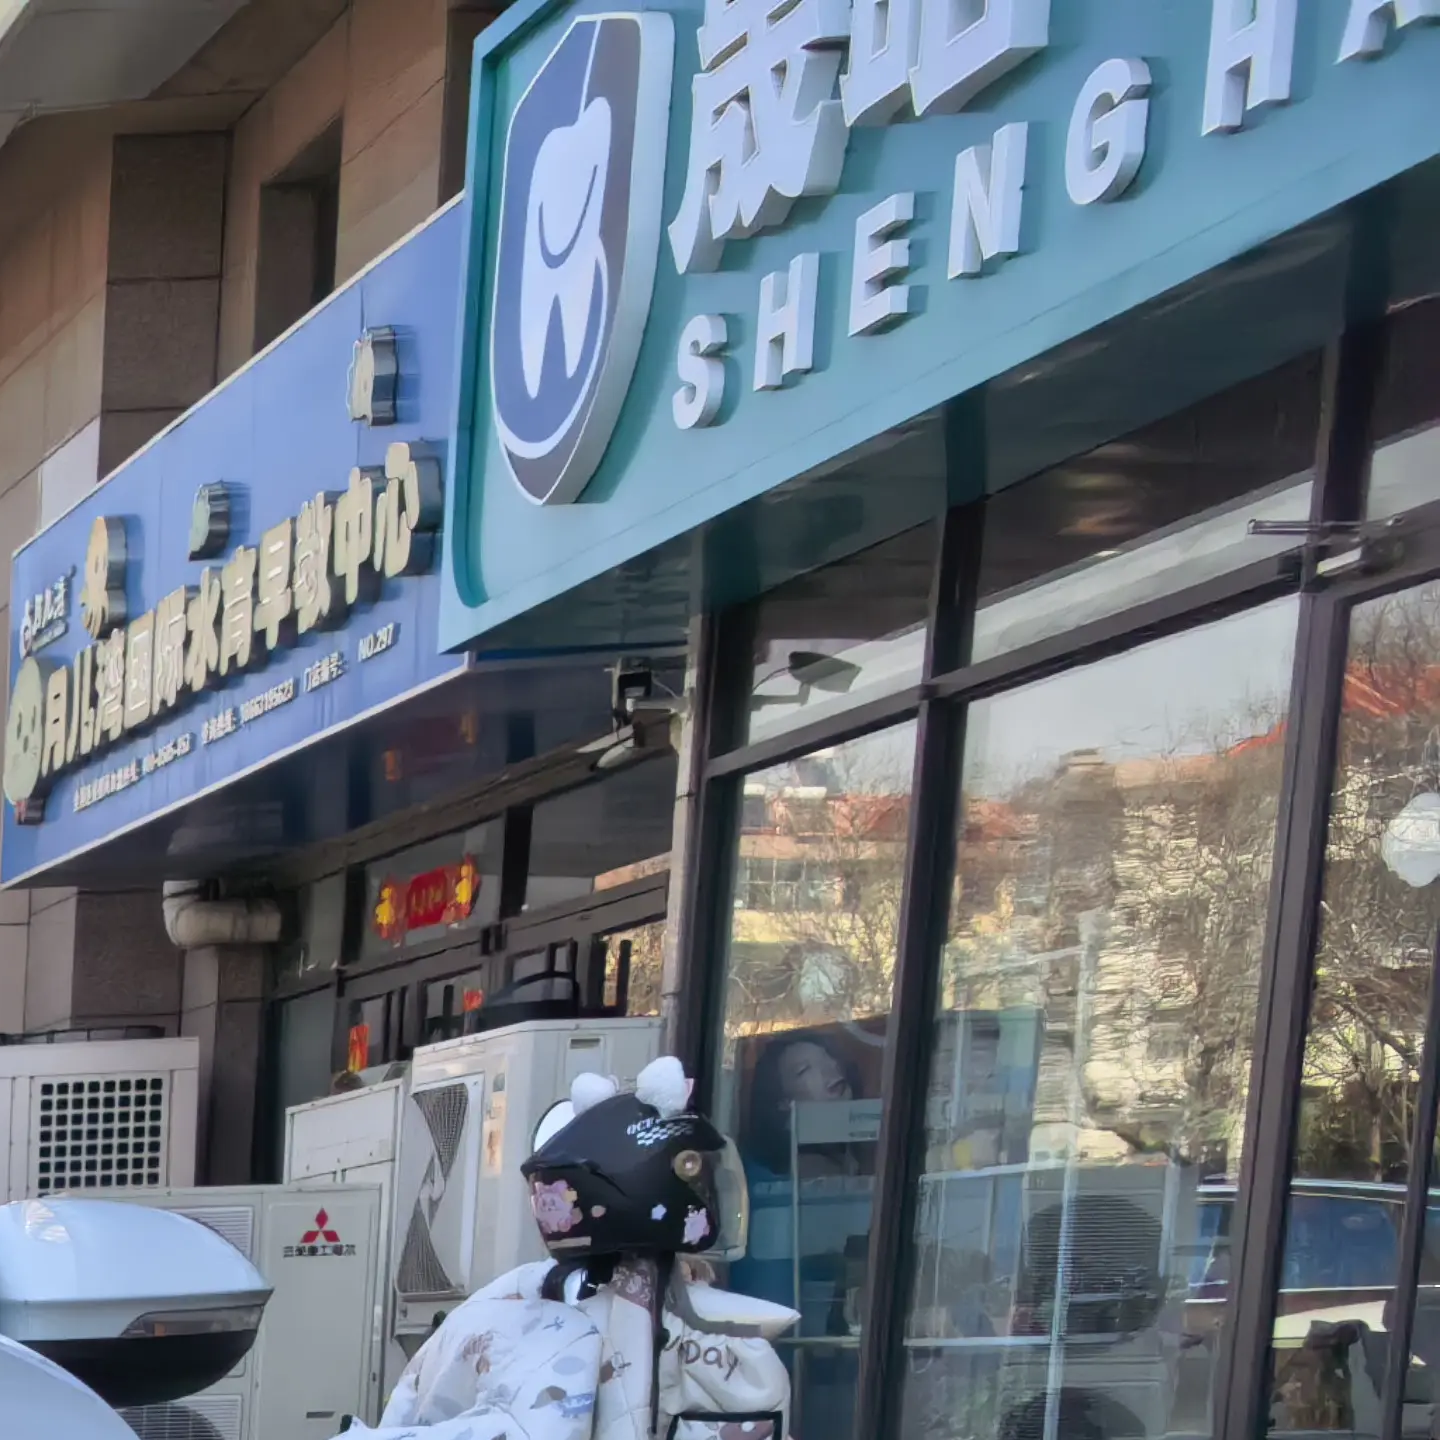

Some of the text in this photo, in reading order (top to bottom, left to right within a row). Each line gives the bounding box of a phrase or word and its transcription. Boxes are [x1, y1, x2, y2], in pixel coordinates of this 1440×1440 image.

[42, 442, 420, 777] 月儿湾国际水育早教中心
[684, 1339, 740, 1382] Day
